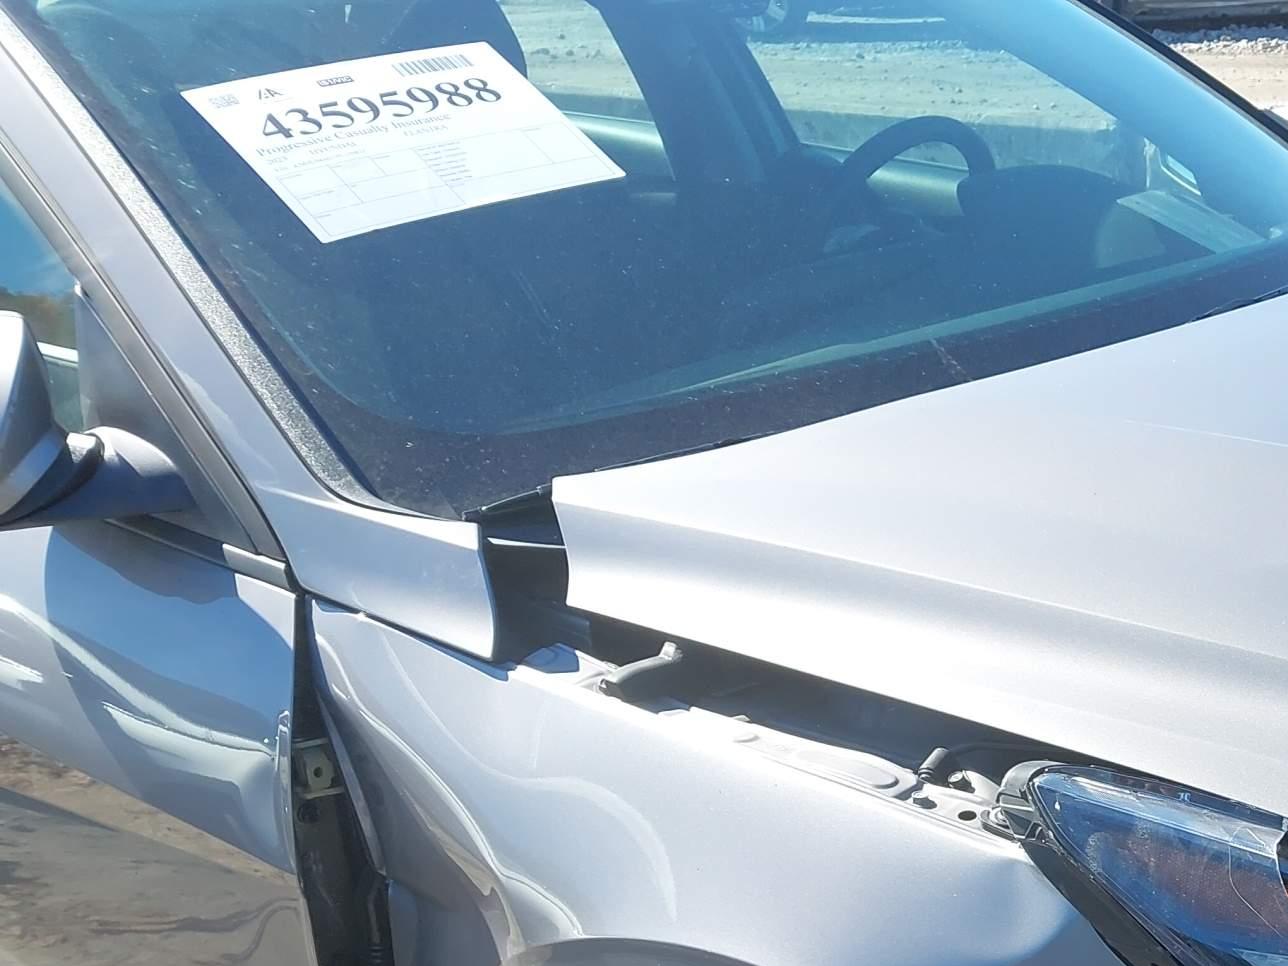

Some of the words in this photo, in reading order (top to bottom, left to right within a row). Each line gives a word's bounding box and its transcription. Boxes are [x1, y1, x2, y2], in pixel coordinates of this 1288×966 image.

[262, 77, 502, 139] 43595988
[256, 135, 332, 157] Progressive
[335, 120, 389, 141] Casualty
[391, 113, 452, 130] Insurance
